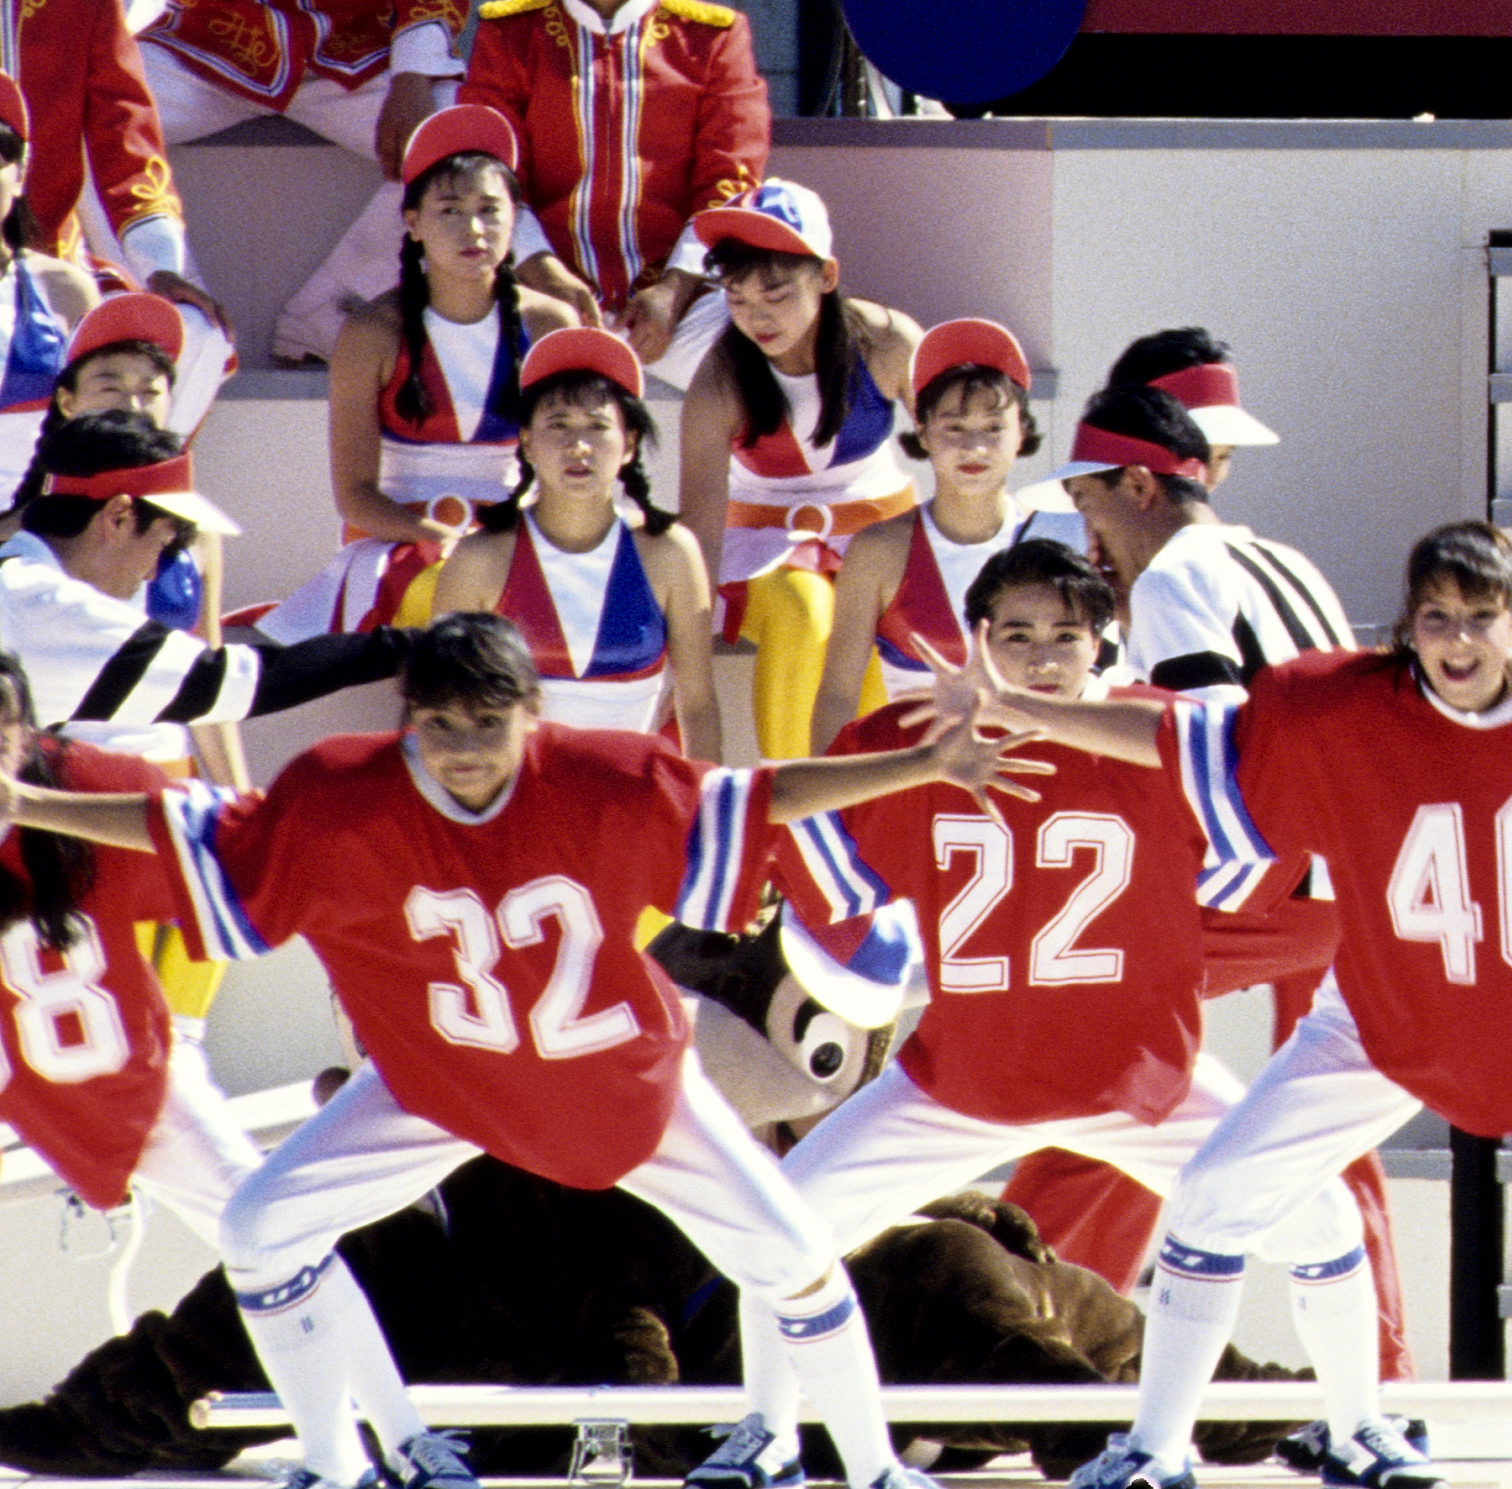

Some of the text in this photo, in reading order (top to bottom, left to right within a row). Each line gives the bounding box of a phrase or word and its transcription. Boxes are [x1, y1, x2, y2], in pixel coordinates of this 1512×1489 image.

[402, 874, 640, 1061] 32
[933, 811, 1135, 994] 22
[0, 912, 131, 1094] 8
